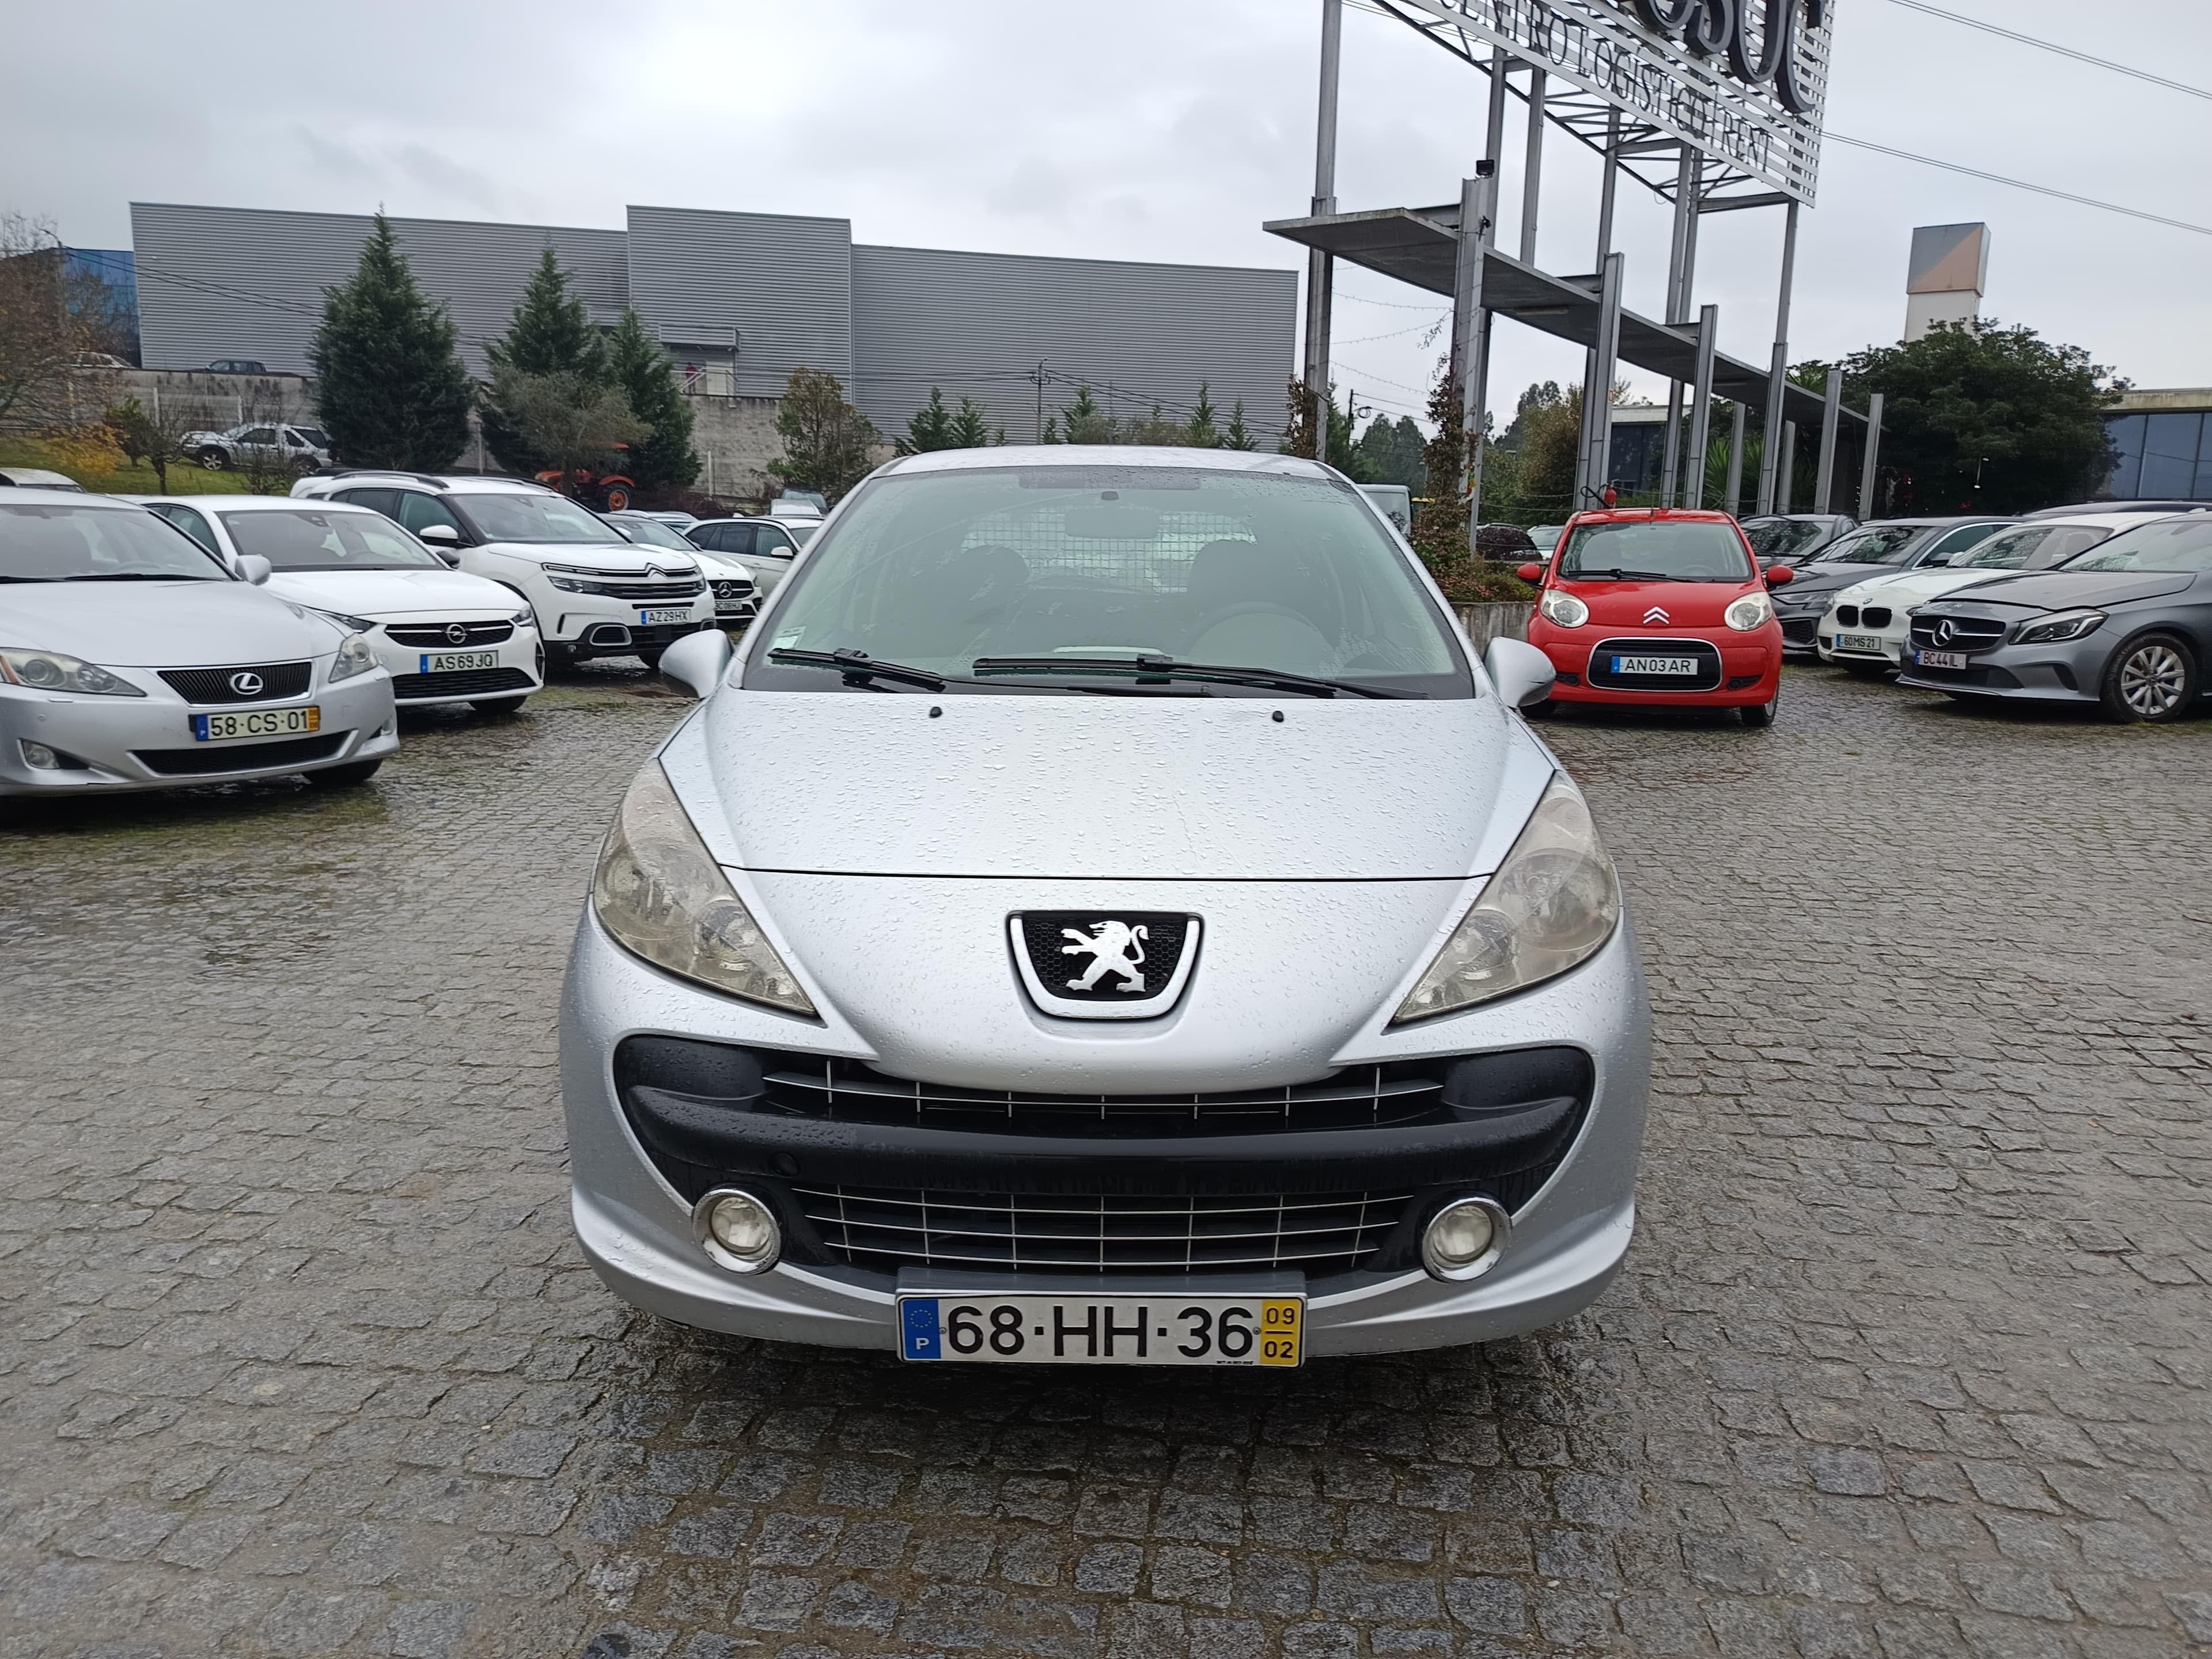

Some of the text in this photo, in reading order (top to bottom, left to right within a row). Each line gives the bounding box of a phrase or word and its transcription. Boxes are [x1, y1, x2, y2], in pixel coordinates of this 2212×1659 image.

[1266, 1308, 1296, 1324] 09
[915, 1337, 930, 1350] P
[1264, 1340, 1294, 1358] 02
